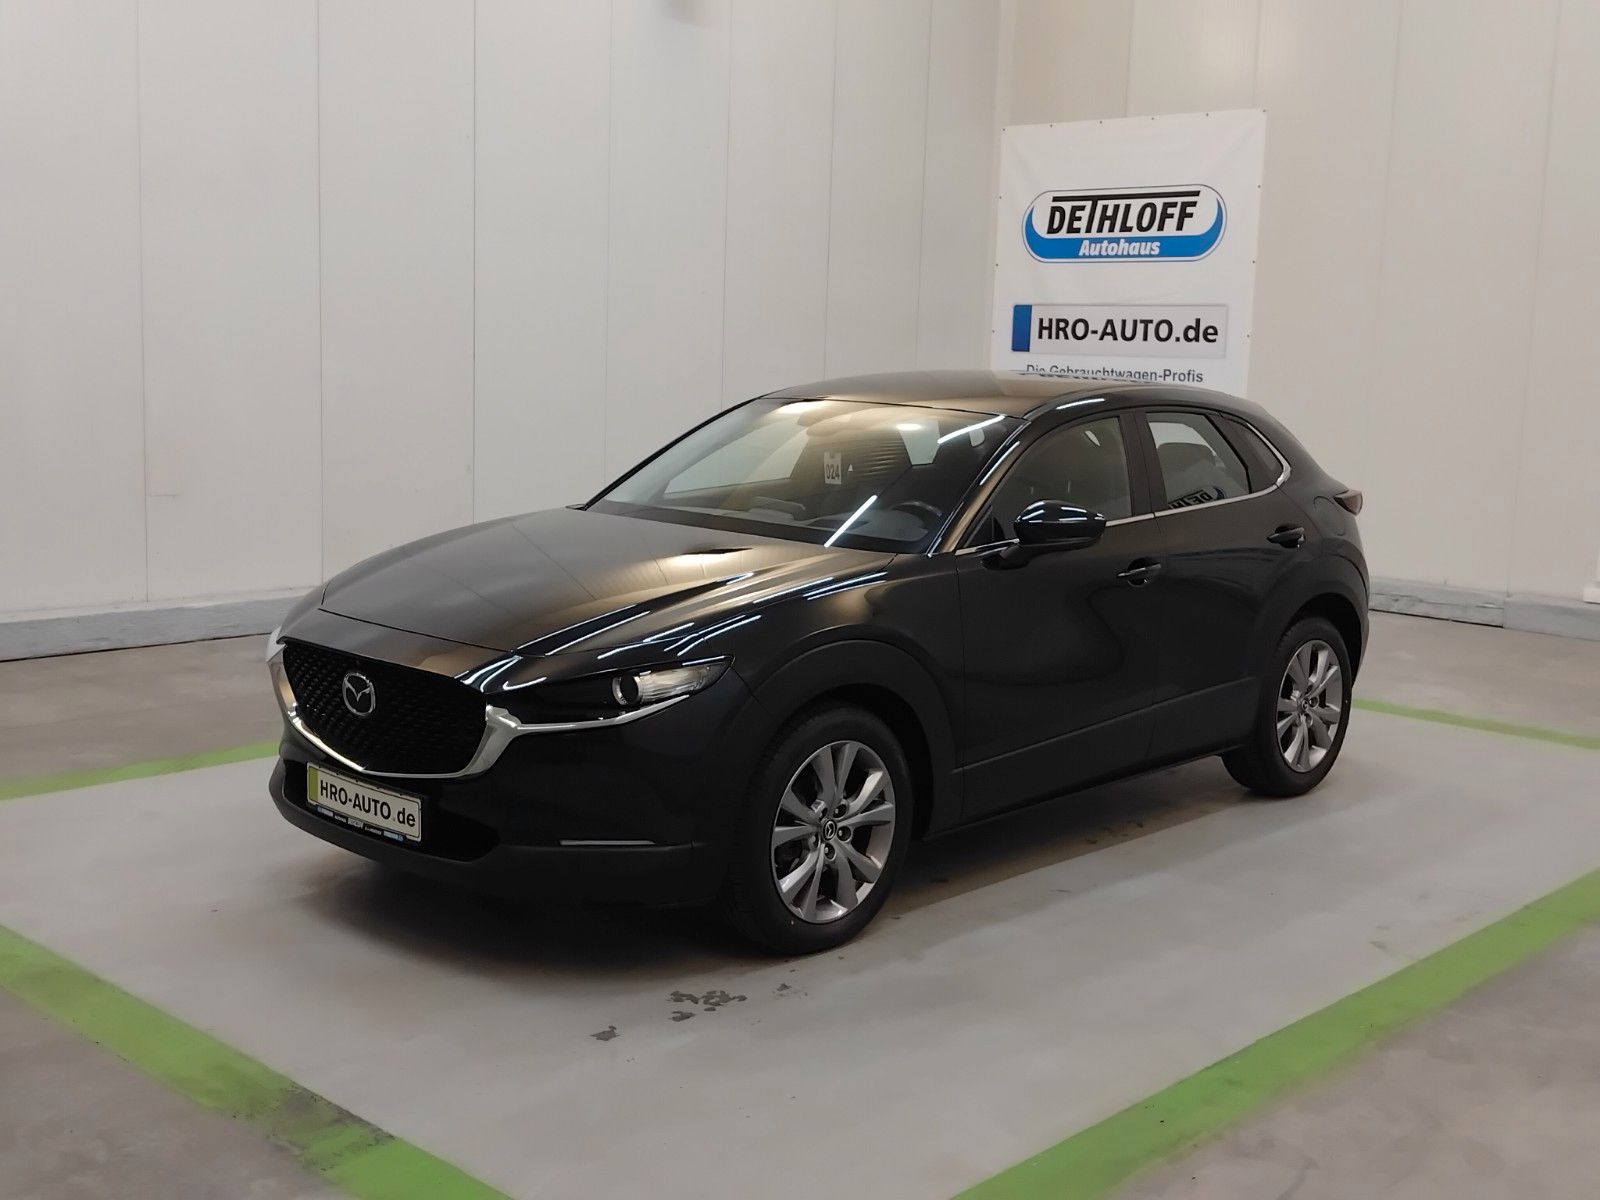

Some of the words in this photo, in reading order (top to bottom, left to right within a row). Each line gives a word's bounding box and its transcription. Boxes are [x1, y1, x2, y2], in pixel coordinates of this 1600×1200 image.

[1047, 190, 1200, 235] DETHLOFF
[1078, 239, 1161, 257] Autohaus
[1037, 317, 1219, 344] HRO-AUTO.de
[825, 463, 841, 480] 024
